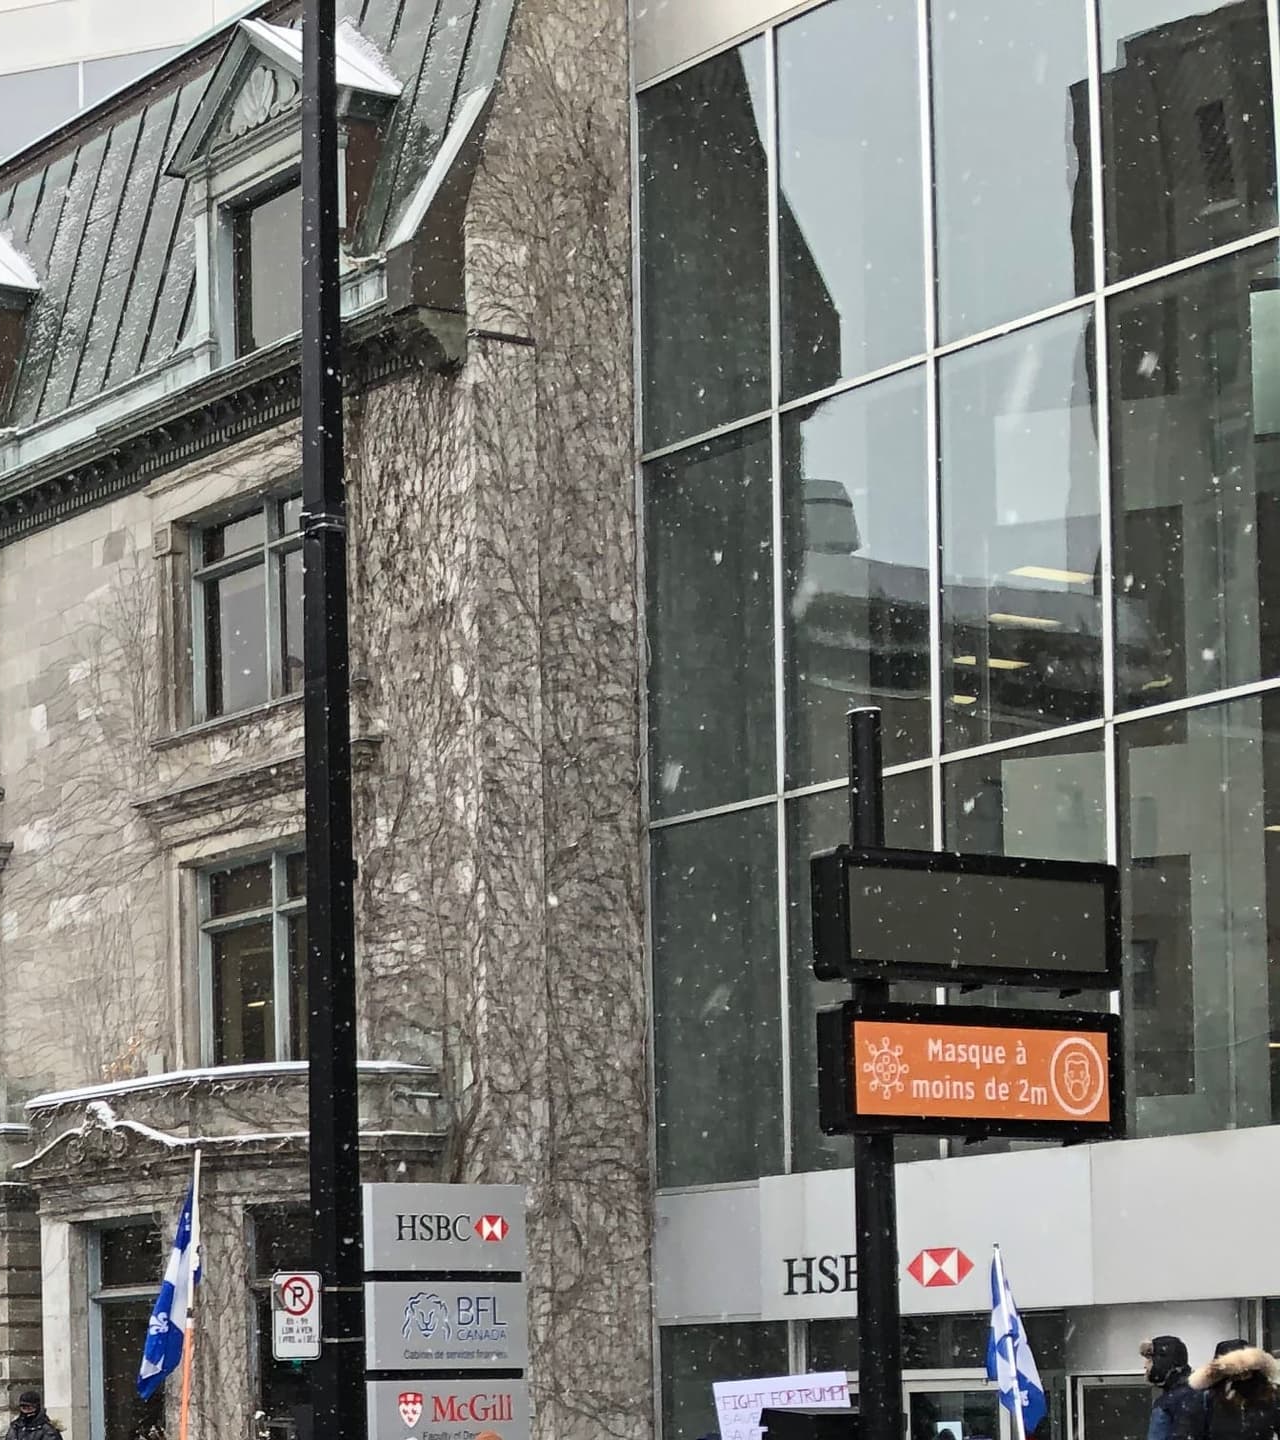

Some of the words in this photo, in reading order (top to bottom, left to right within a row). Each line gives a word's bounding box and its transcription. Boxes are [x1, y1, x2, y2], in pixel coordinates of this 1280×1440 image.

[927, 1038, 1006, 1070] Masque
[1015, 1040, 1028, 1065] à
[911, 1075, 976, 1101] moins
[984, 1076, 1010, 1101] de
[1018, 1081, 1048, 1105] 2m
[395, 1213, 472, 1242] HSBC
[456, 1296, 508, 1326] BFL
[456, 1329, 507, 1341] CANADA
[431, 1393, 513, 1422] McGill
[722, 1392, 765, 1410] FIGHT
[453, 1431, 461, 1440] of
